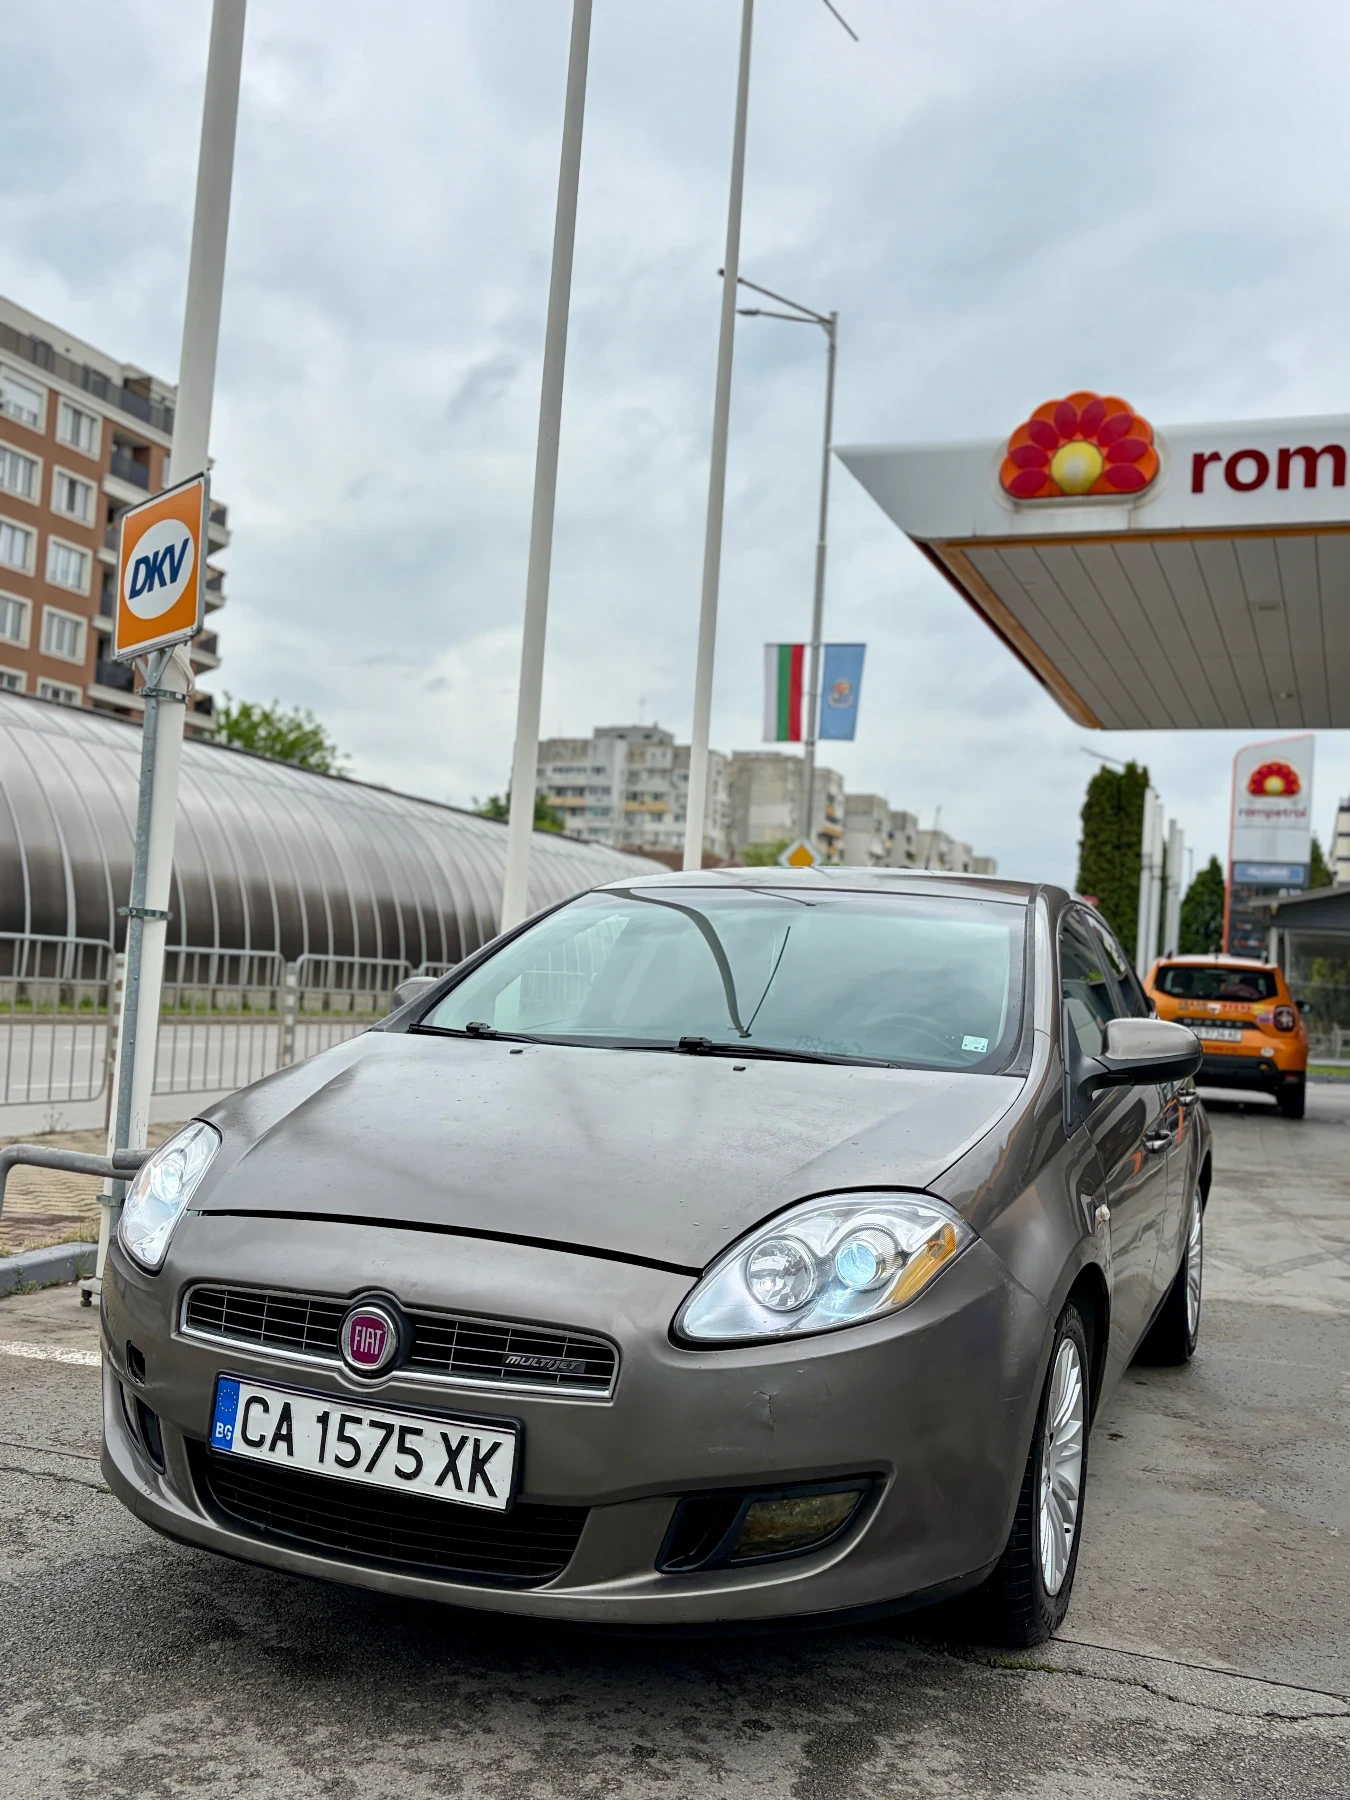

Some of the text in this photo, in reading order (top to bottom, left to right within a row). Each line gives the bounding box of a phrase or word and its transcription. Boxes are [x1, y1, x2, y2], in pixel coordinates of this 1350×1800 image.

[1192, 444, 1346, 494] rom
[128, 537, 190, 600] DKV
[1238, 806, 1307, 821] rompetrol
[353, 1325, 384, 1355] FIAT
[505, 1354, 582, 1371] MULTIJET
[215, 1421, 233, 1441] BG
[240, 1395, 503, 1498] CA 1575 XK
